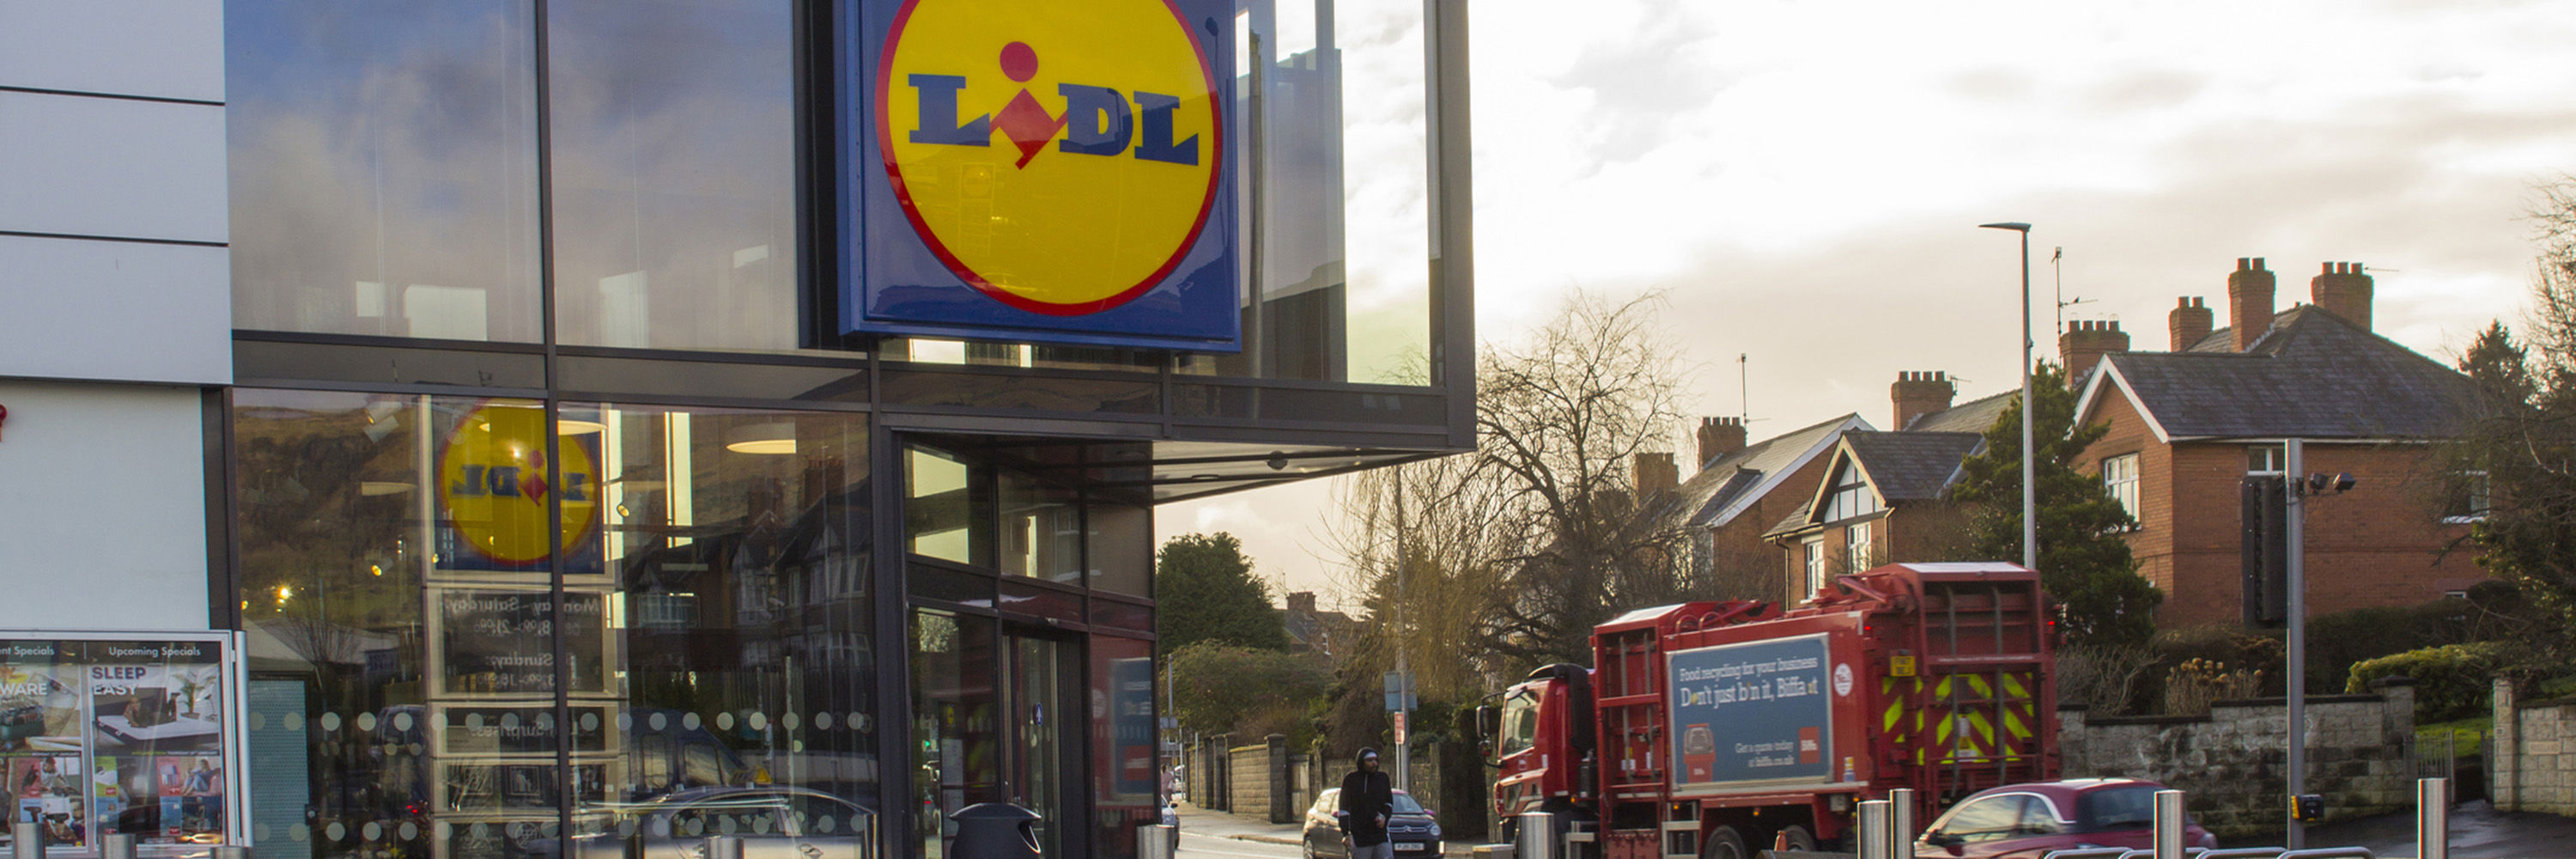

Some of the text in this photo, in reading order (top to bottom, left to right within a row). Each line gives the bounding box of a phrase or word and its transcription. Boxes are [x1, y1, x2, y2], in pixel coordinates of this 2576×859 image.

[14, 645, 55, 658] Specials
[109, 646, 201, 658] Upcoming Specials
[92, 667, 146, 679] SLEEP
[1679, 655, 1818, 682] Food recycling for your business
[94, 684, 138, 696] EASY
[1713, 684, 1736, 710] just
[1777, 675, 1807, 698] Biffa
